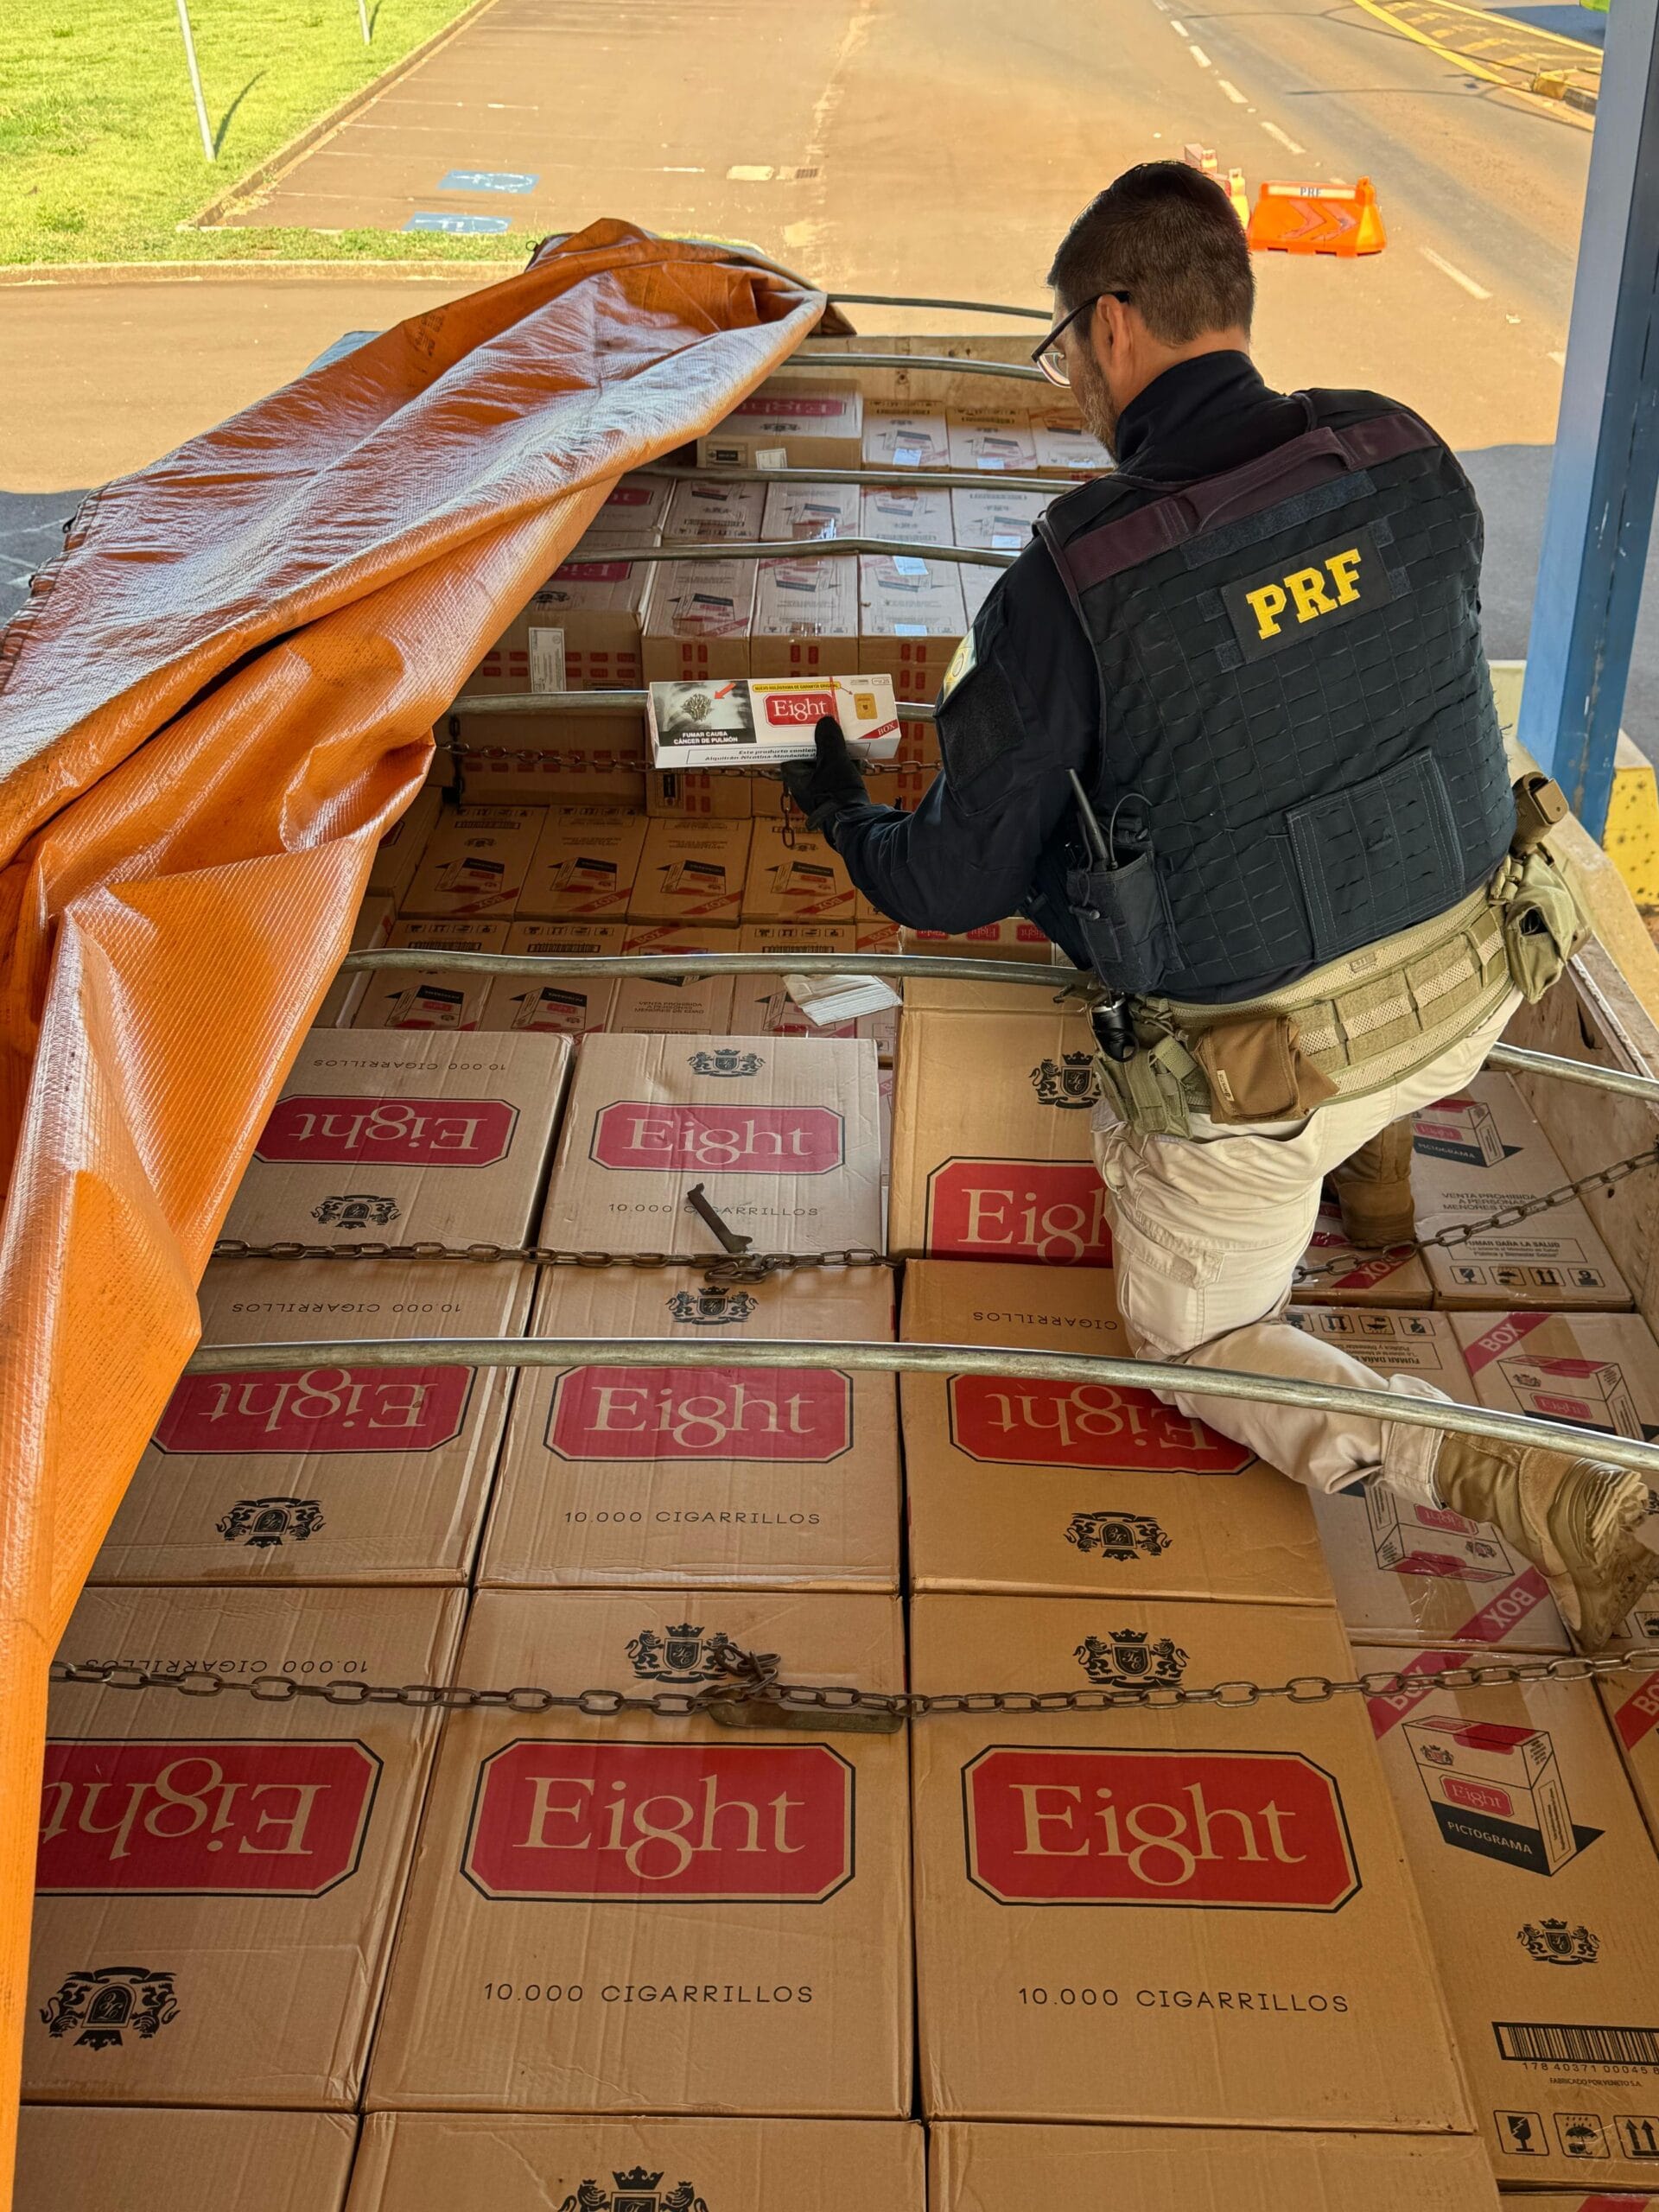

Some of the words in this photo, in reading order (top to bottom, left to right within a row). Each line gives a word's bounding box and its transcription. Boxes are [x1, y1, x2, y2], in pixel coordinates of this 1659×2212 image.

[1300, 187, 1322, 198] PRF
[1245, 548, 1362, 640] PRF
[772, 697, 827, 721] Eight
[877, 722, 895, 735] BOX
[594, 894, 619, 907] BOX
[701, 897, 728, 910] BOX
[814, 898, 842, 910] BOX
[635, 930, 664, 944] BOX
[313, 1059, 439, 1070] CIGARRILLOS
[289, 1104, 489, 1150] Eight
[622, 1118, 814, 1166] Eight
[1417, 1141, 1476, 1159] PICTOGRAMA
[608, 1203, 672, 1215] 10.000
[683, 1205, 819, 1217] CGARRILLOS
[957, 1187, 1105, 1266] Eigh
[232, 1303, 380, 1313] CIGARRILLOS
[392, 1304, 461, 1313] 10.000
[973, 1312, 1118, 1331] CIGARRILLOS
[1478, 1323, 1525, 1352] BOX
[198, 1369, 438, 1433] Eight
[583, 1382, 816, 1448] Eight
[985, 1384, 1217, 1451] Eight
[564, 1511, 643, 1523] 10.000
[655, 1511, 821, 1524] CIGARRILLOS
[1483, 1587, 1537, 1629] BOX
[282, 1661, 368, 1674] 10.000
[1452, 1784, 1503, 1810] Eight
[39, 1758, 332, 1860] Eight
[512, 1775, 806, 1880] Eight
[1009, 1782, 1307, 1886] Eight
[1447, 1820, 1533, 1855] PICTOGRAMA
[484, 1982, 584, 2002] 10.000
[601, 1985, 814, 2003] CIGARRILLOS
[1018, 1987, 1119, 2005] 10.000
[1136, 1989, 1350, 2012] CIGARRILLOS
[1523, 2062, 1549, 2071] 178
[1554, 2063, 1598, 2072] 40371
[1604, 2065, 1649, 2075] 00045
